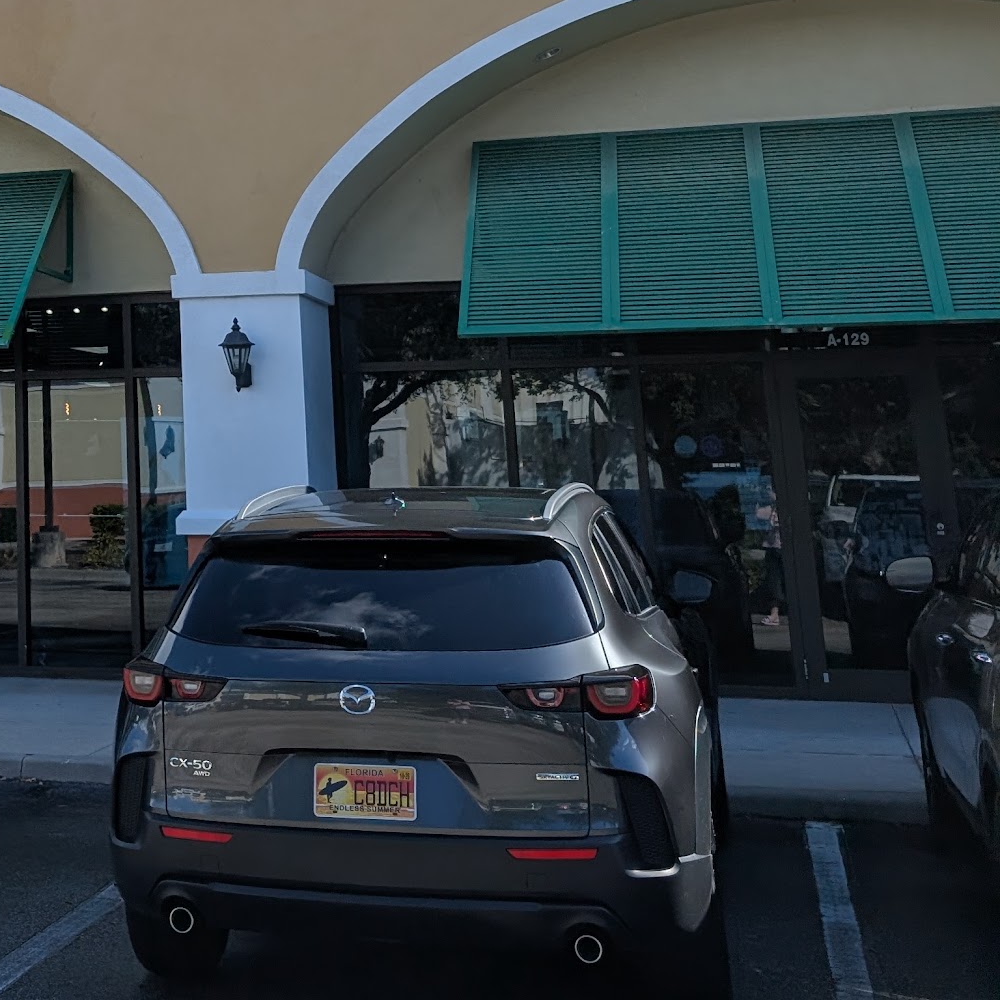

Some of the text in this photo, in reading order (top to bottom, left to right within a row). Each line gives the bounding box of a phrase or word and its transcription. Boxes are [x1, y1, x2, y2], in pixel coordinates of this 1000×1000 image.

[827, 332, 870, 346] A-129
[170, 757, 212, 770] CX-50
[345, 768, 383, 776] FLORIDA
[329, 804, 401, 813] ENDLESS SUMMER
